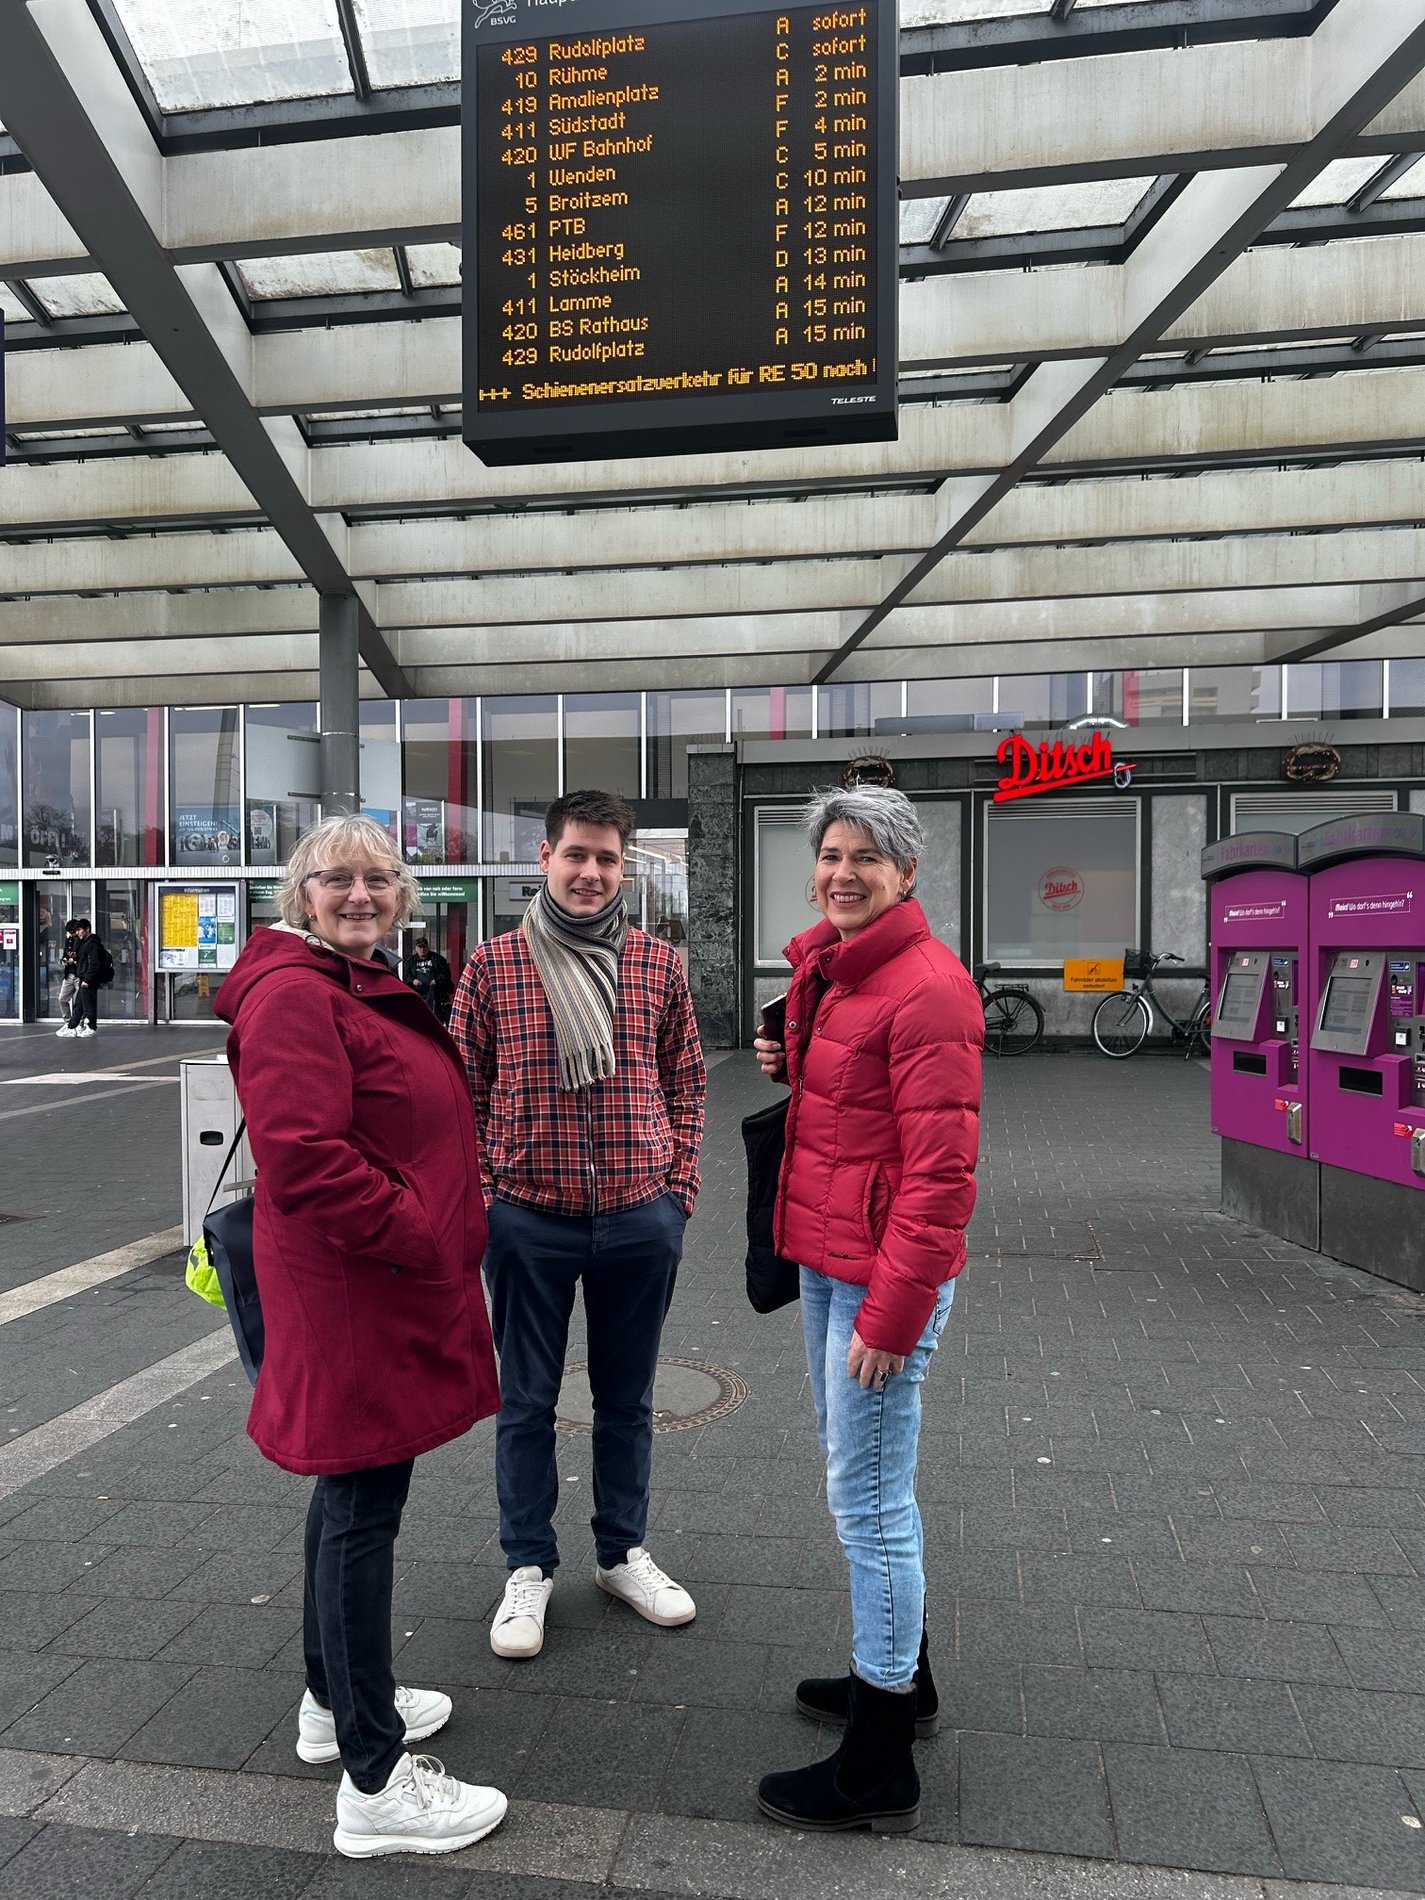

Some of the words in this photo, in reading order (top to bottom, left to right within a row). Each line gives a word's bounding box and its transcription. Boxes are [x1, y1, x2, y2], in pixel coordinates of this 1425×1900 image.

[490, 15, 517, 26] BSVG
[502, 46, 537, 65] 429
[549, 35, 645, 60] Rudolfplatz
[776, 17, 789, 34] A
[812, 8, 867, 31] sofort
[516, 71, 537, 89] 10
[549, 67, 608, 84] Rühme
[776, 43, 789, 60] C
[812, 35, 867, 56] sofort
[502, 97, 537, 114] 419
[549, 84, 659, 111] Amalienplatz
[776, 69, 789, 86] A
[815, 65, 828, 82] 2
[834, 63, 867, 79] min
[502, 122, 536, 139] 411
[549, 111, 626, 135] Südstadt
[776, 95, 788, 112] F
[815, 91, 828, 108] 2
[834, 89, 867, 105] min
[502, 147, 537, 165] 420
[549, 141, 577, 160] WF
[583, 135, 653, 158] Bahnhof
[776, 120, 788, 137] F
[814, 117, 828, 133] 4
[834, 115, 866, 131] min
[528, 171, 536, 187] 1
[549, 165, 616, 185] Wenden
[776, 147, 788, 163] C
[814, 143, 828, 160] 5
[834, 141, 866, 157] min
[525, 197, 537, 213] 5
[549, 191, 628, 212] Broitzem
[776, 173, 788, 189] C
[804, 169, 827, 186] 10
[834, 168, 866, 184] min
[502, 222, 536, 240] 461
[549, 217, 586, 237] PTB
[776, 199, 788, 215] A
[804, 194, 827, 212] 12
[834, 193, 866, 209] min
[502, 248, 536, 266] 431
[549, 242, 624, 262] Heidberg
[776, 225, 788, 241] F
[804, 220, 827, 238] 12
[834, 219, 866, 236] min
[528, 273, 536, 289] 1
[549, 266, 641, 287] Stöckheim
[776, 250, 788, 267] D
[804, 246, 827, 264] 13
[834, 246, 866, 262] min
[502, 298, 536, 315] 411
[549, 295, 612, 313] Lamme
[776, 276, 788, 293] A
[804, 272, 827, 290] 14
[834, 272, 866, 288] min
[502, 323, 537, 341] 420
[549, 319, 574, 338] BS
[579, 316, 649, 334] Rathaus
[776, 302, 788, 319] A
[804, 298, 827, 316] 15
[834, 298, 866, 314] min
[502, 348, 537, 366] 429
[549, 340, 645, 363] Rudolfplatz
[776, 328, 788, 345] A
[804, 324, 827, 342] 15
[834, 324, 866, 340] min
[522, 371, 722, 400] Schienenersatzverkehr
[728, 367, 754, 385] für
[759, 363, 785, 383] RE
[791, 361, 817, 380] 50
[823, 358, 868, 379] nach
[831, 395, 877, 405] TELESTE
[996, 730, 1113, 791] Ditsch
[1045, 880, 1077, 895] Ditsch
